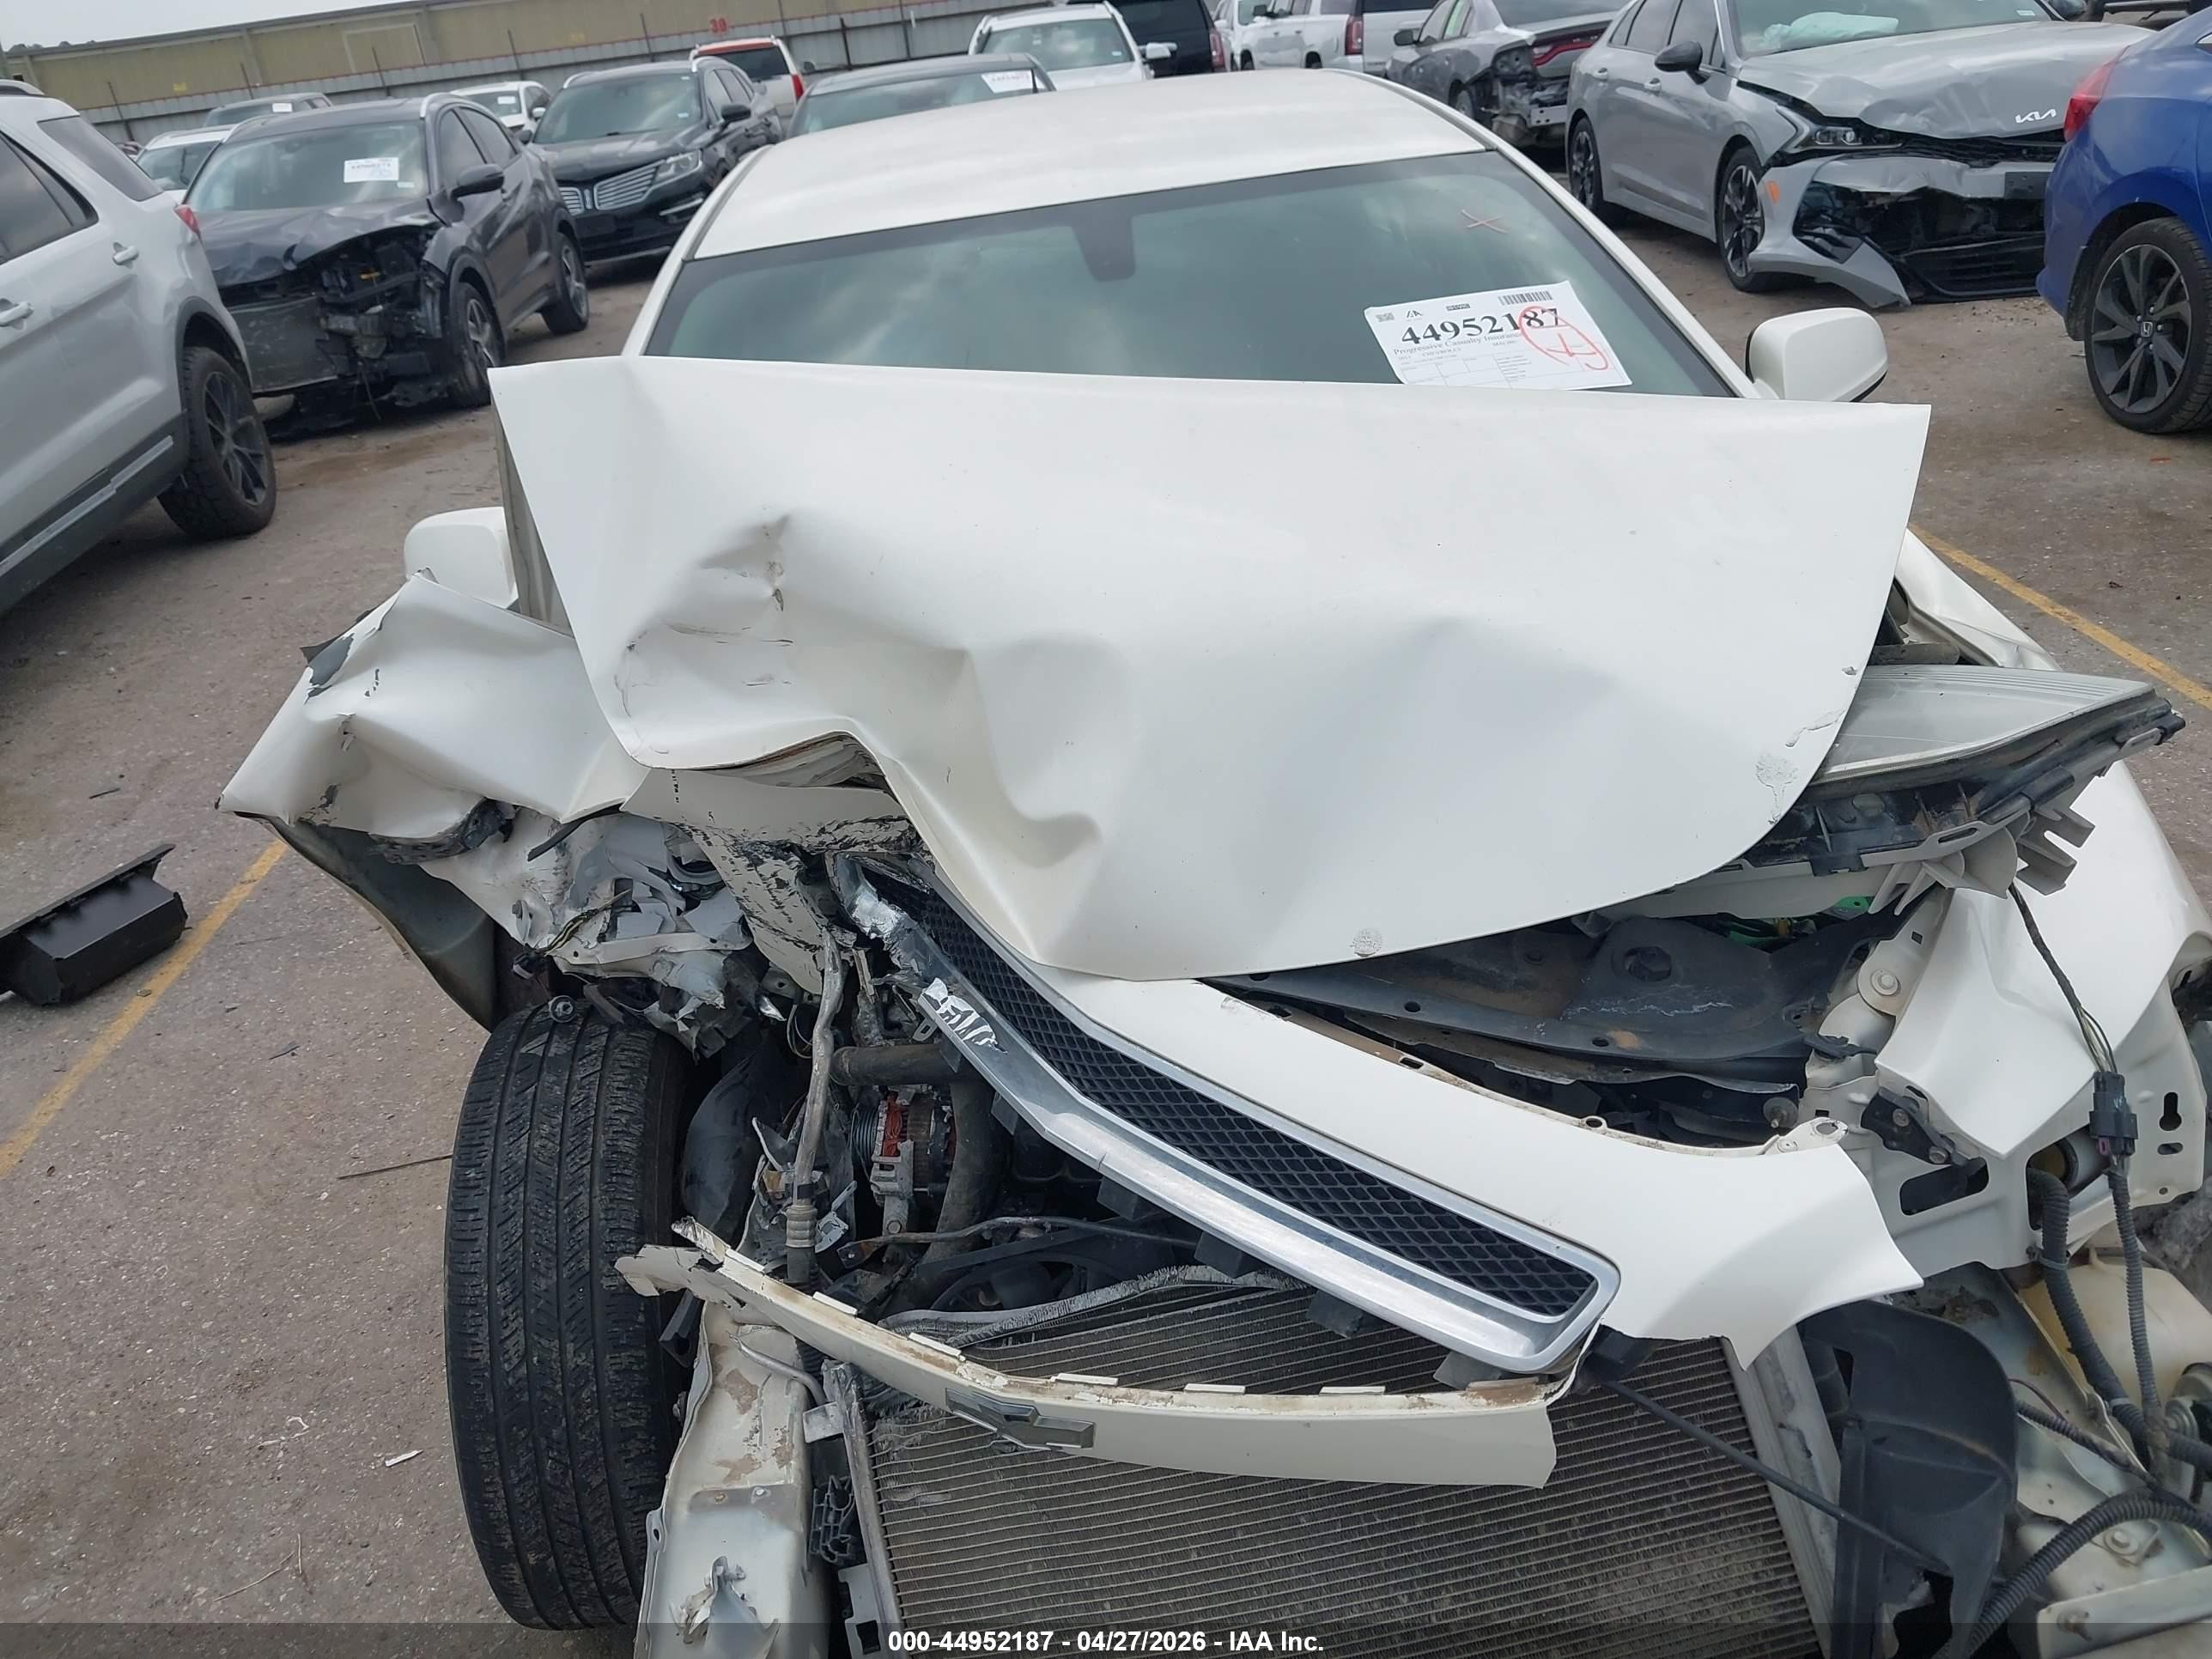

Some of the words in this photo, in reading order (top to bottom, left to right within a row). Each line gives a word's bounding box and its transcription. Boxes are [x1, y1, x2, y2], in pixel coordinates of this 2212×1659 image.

[1401, 307, 1559, 344] 44952187
[1394, 343, 1443, 356] Progressive
[1444, 337, 1481, 347] Casualty
